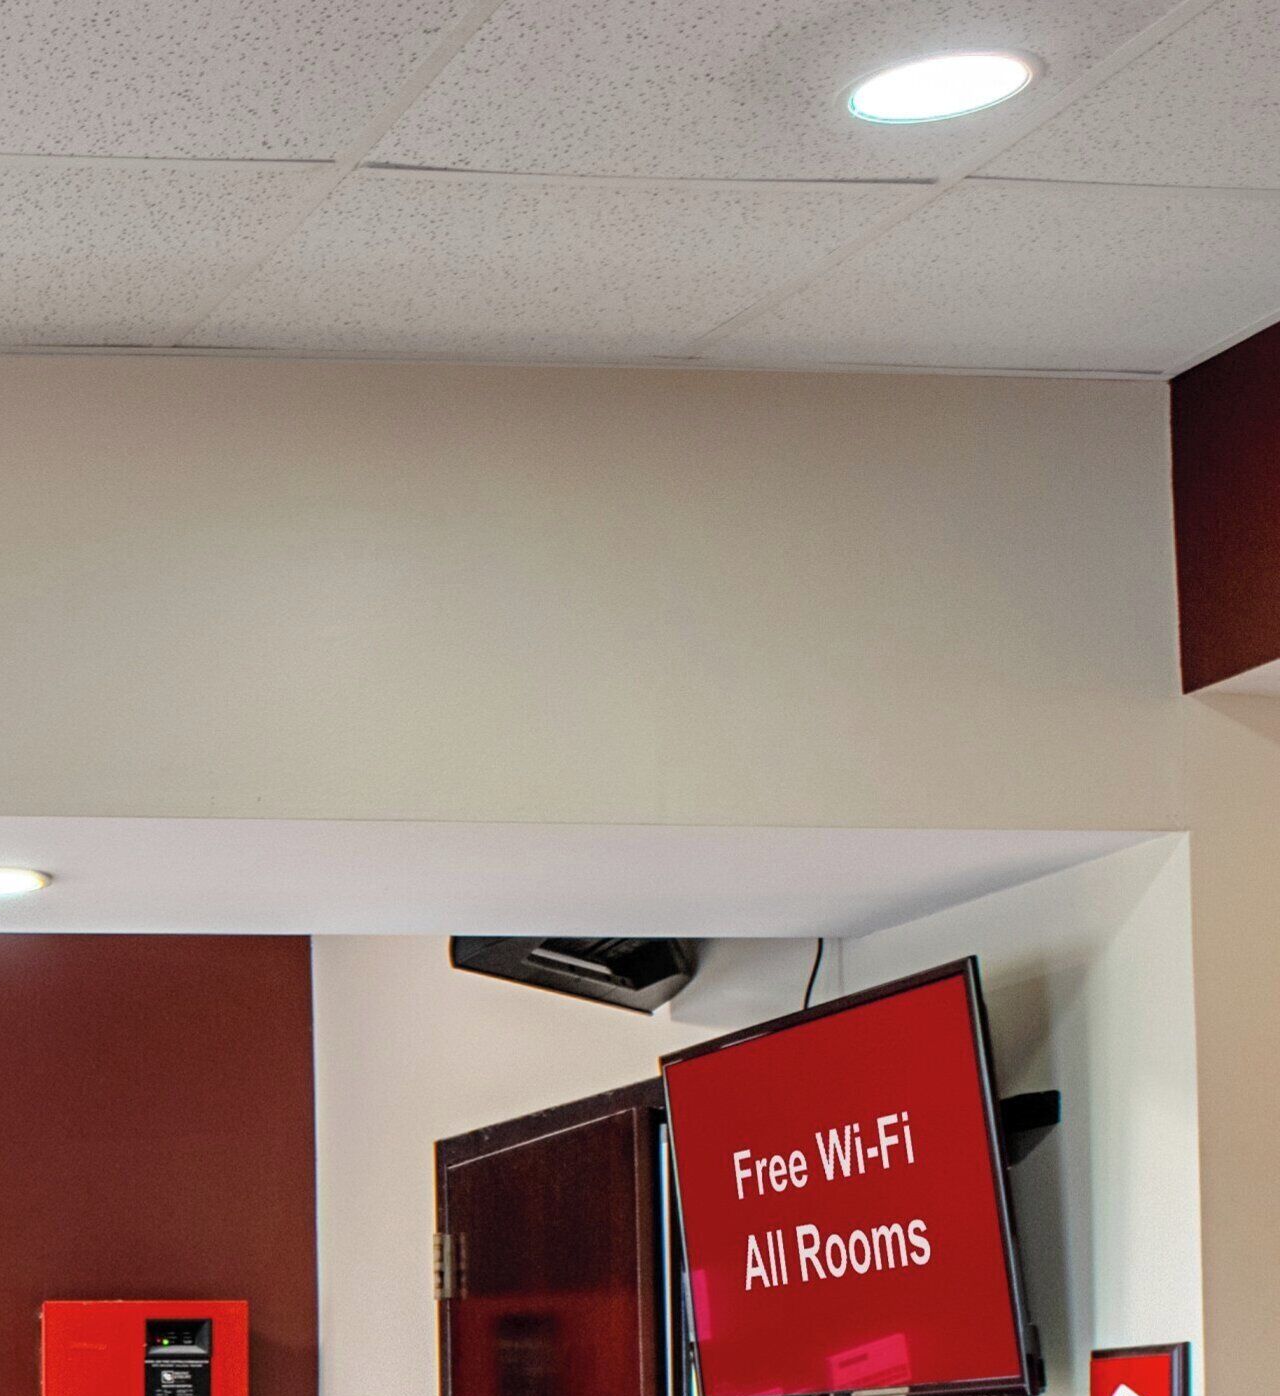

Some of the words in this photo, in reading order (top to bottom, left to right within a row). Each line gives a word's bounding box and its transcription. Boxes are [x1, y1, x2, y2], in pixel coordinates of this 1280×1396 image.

[733, 1149, 809, 1200] Free
[815, 1111, 915, 1181] Wi-Fi
[745, 1229, 788, 1291] All
[796, 1219, 931, 1282] Rooms
